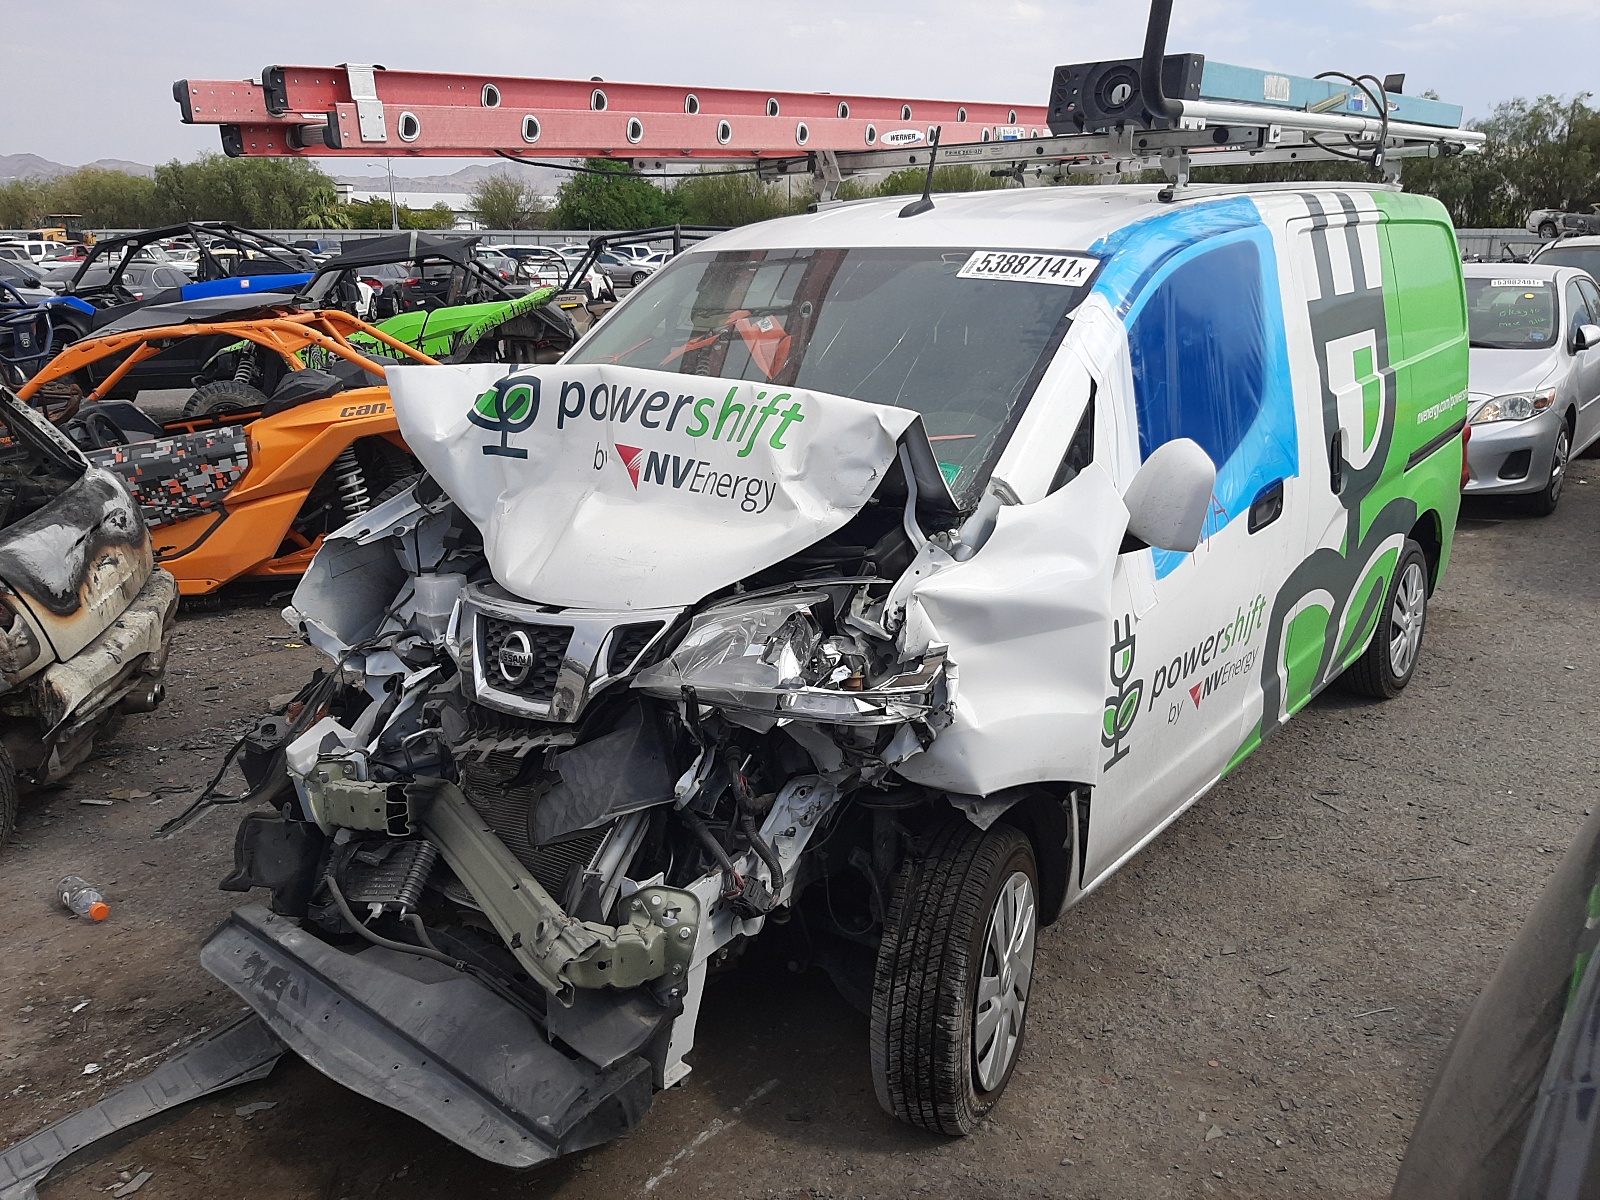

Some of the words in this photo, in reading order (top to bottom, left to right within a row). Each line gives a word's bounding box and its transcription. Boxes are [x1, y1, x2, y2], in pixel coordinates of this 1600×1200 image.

[340, 403, 394, 417] can-
[557, 381, 804, 457] powershift
[593, 441, 608, 470] b
[643, 450, 777, 514] NVEnergy
[1148, 594, 1266, 712] powershift
[1167, 699, 1184, 726] by
[1202, 646, 1259, 700] NVEnergy
